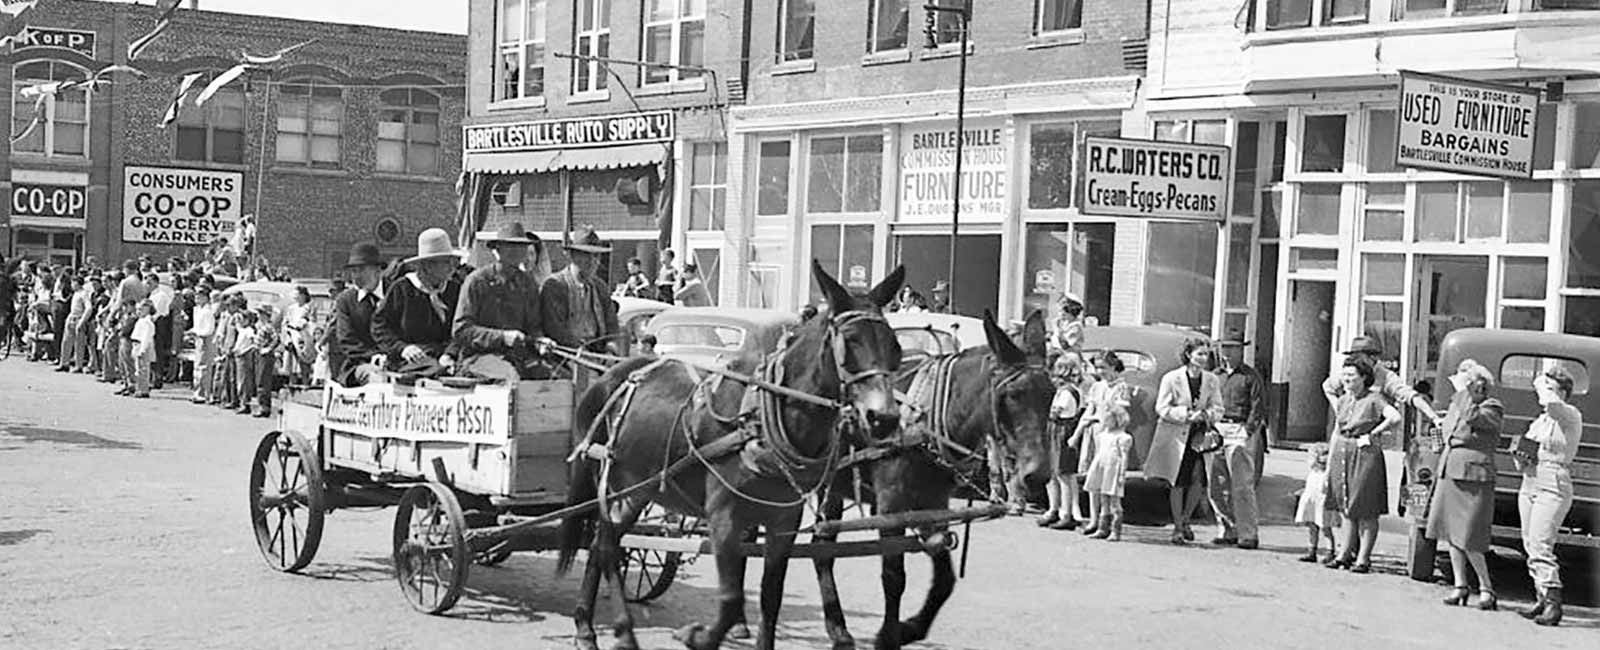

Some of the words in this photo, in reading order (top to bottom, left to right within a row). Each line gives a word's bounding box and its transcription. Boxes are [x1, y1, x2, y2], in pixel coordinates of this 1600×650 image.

[69, 34, 85, 47] P
[1404, 92, 1441, 126] USED
[1455, 99, 1532, 138] FURNITURE
[467, 122, 562, 149] BARTLESVILLE
[566, 120, 604, 145] AUTO
[608, 114, 669, 140] SUPPLY
[913, 128, 1001, 150] BARTLEVILLE
[1421, 129, 1509, 156] BARGAINS
[1197, 153, 1222, 180] CO.
[1400, 145, 1451, 164] BARTLESVILLE
[130, 173, 234, 192] CONSUMERS
[13, 187, 84, 215] CO-OP
[135, 192, 231, 218] CO-OP
[130, 217, 220, 231] GROCERY
